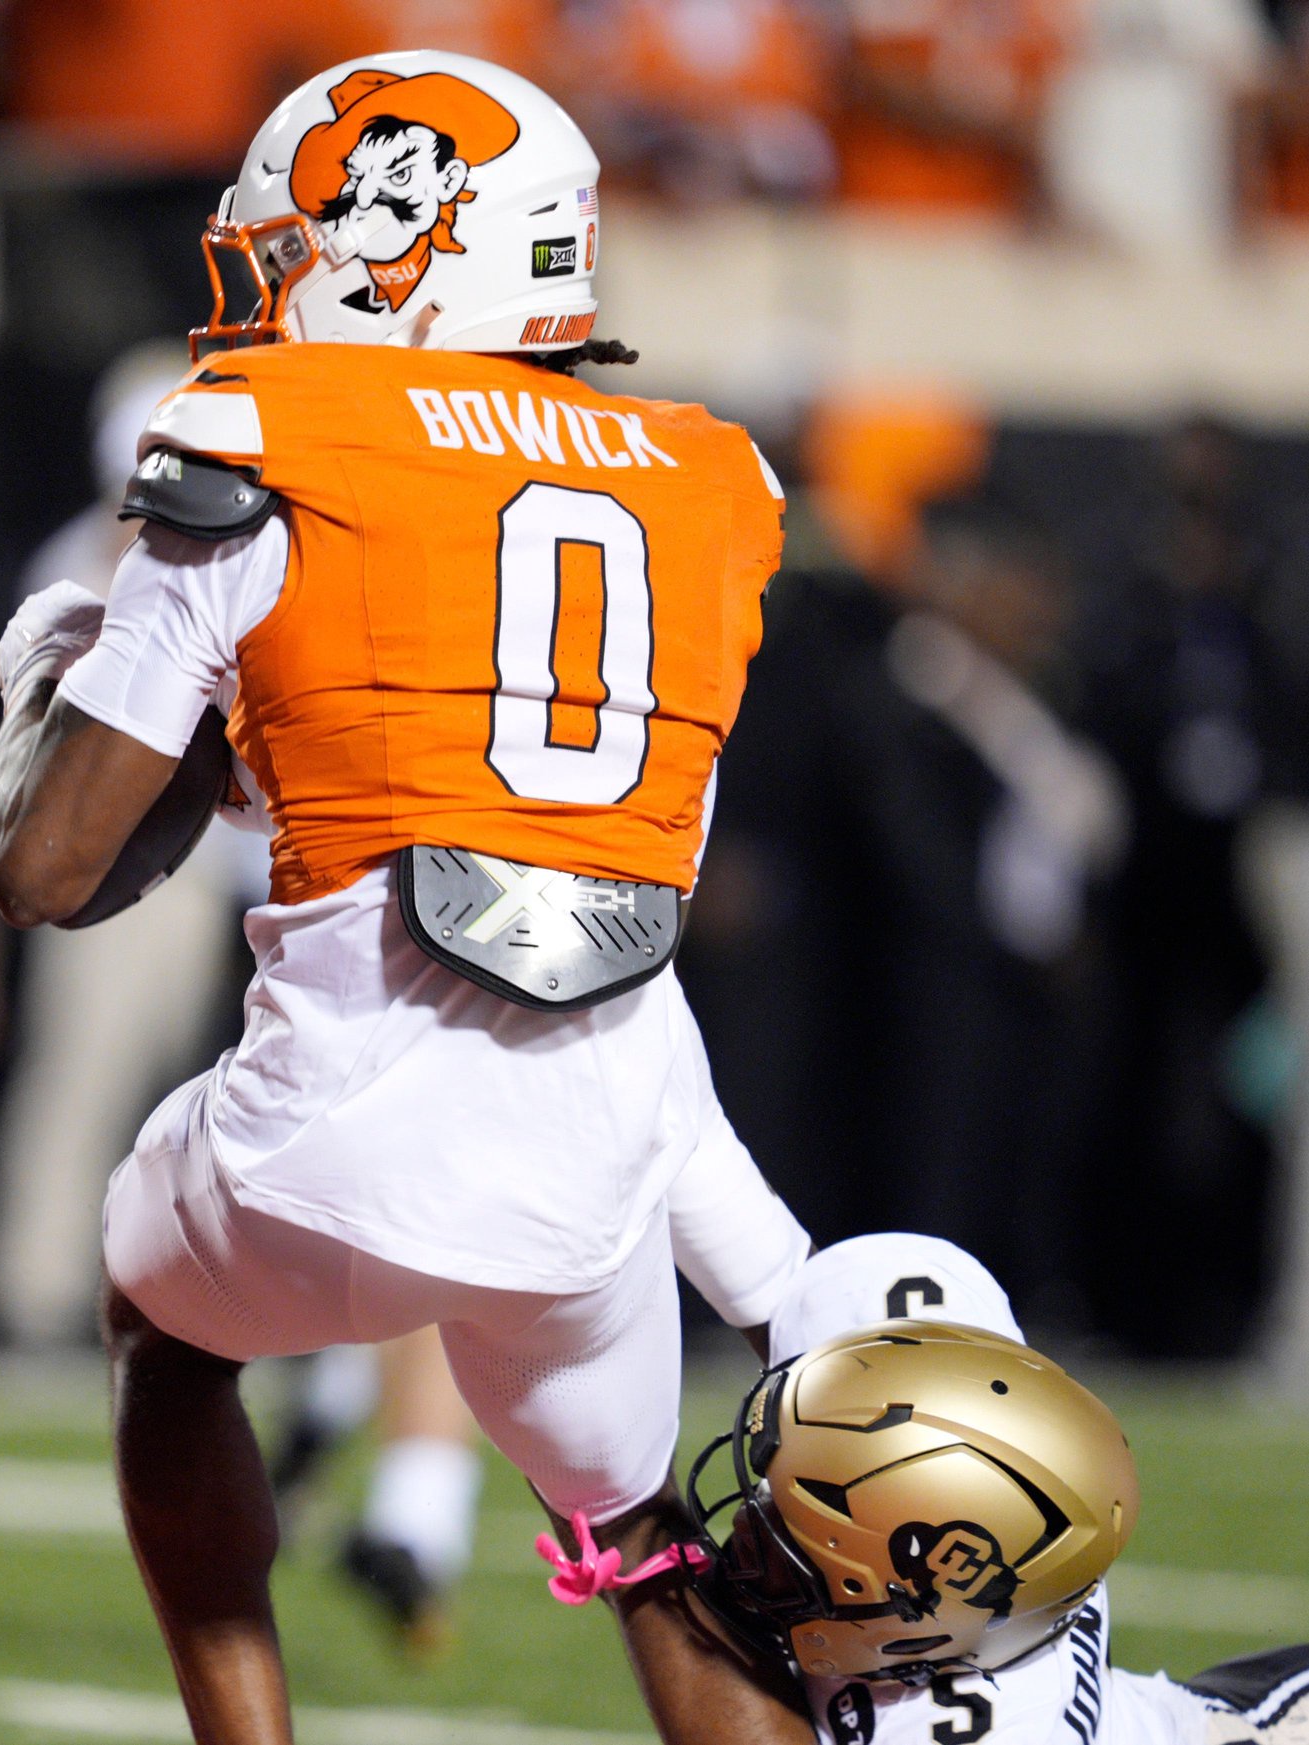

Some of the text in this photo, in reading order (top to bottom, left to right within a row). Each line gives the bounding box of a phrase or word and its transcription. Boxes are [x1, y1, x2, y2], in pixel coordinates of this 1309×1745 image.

[371, 262, 419, 286] OSU
[405, 387, 680, 469] BOWICK
[484, 480, 659, 806] 0
[931, 1672, 993, 1745] 5
